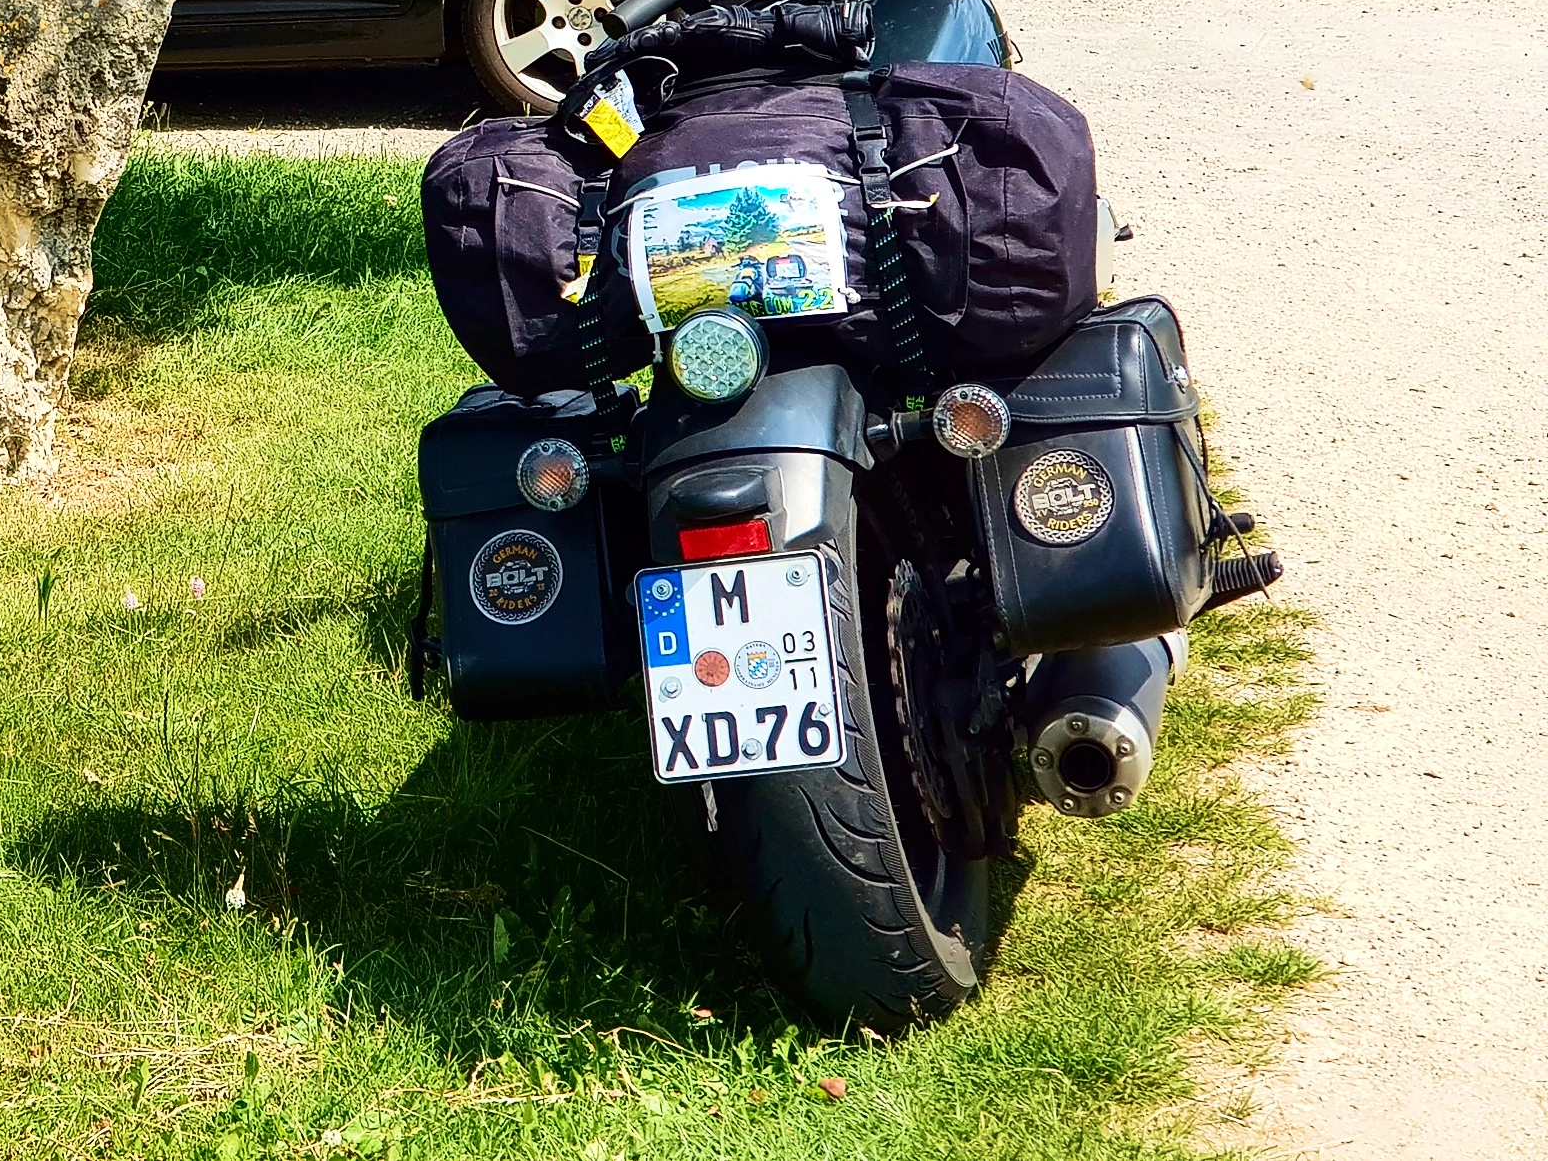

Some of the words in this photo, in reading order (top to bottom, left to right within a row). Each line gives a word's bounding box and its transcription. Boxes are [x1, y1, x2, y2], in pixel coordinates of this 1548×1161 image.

[1033, 463, 1088, 489] GERMAN
[1031, 483, 1096, 510] BOLT
[1047, 510, 1093, 531] RIDERS
[493, 545, 537, 563] GERMAN
[485, 566, 548, 587] BOLT
[495, 594, 537, 609] RIDERS
[710, 569, 750, 626] M
[658, 631, 677, 656] D
[782, 630, 816, 654] 03
[789, 666, 818, 691] 11
